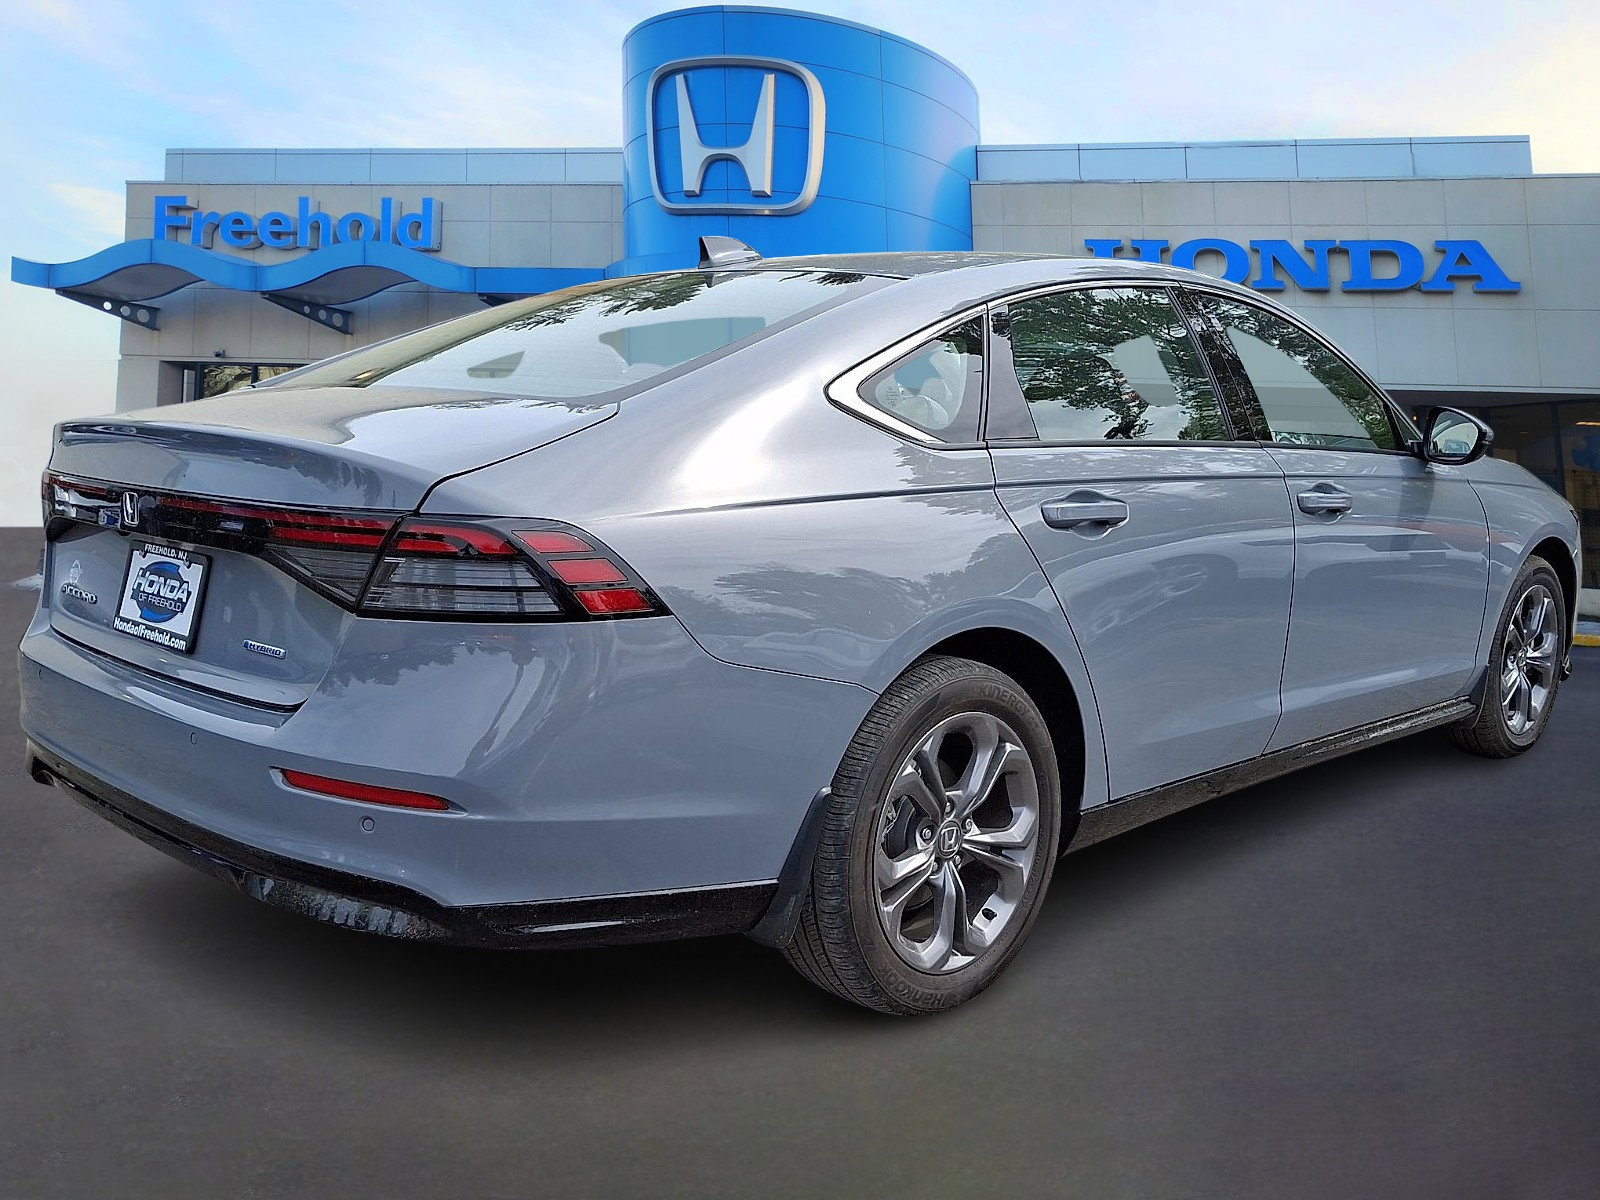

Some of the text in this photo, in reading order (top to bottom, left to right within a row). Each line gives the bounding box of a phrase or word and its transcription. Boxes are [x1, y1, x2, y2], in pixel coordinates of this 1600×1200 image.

[154, 195, 440, 250] Freehold
[62, 584, 97, 603] ACCORD
[133, 569, 189, 602] HONDA
[138, 592, 182, 612] OF FREEHOLD
[113, 617, 186, 651] HondaofFreehold.com
[249, 642, 282, 656] HYBRID
